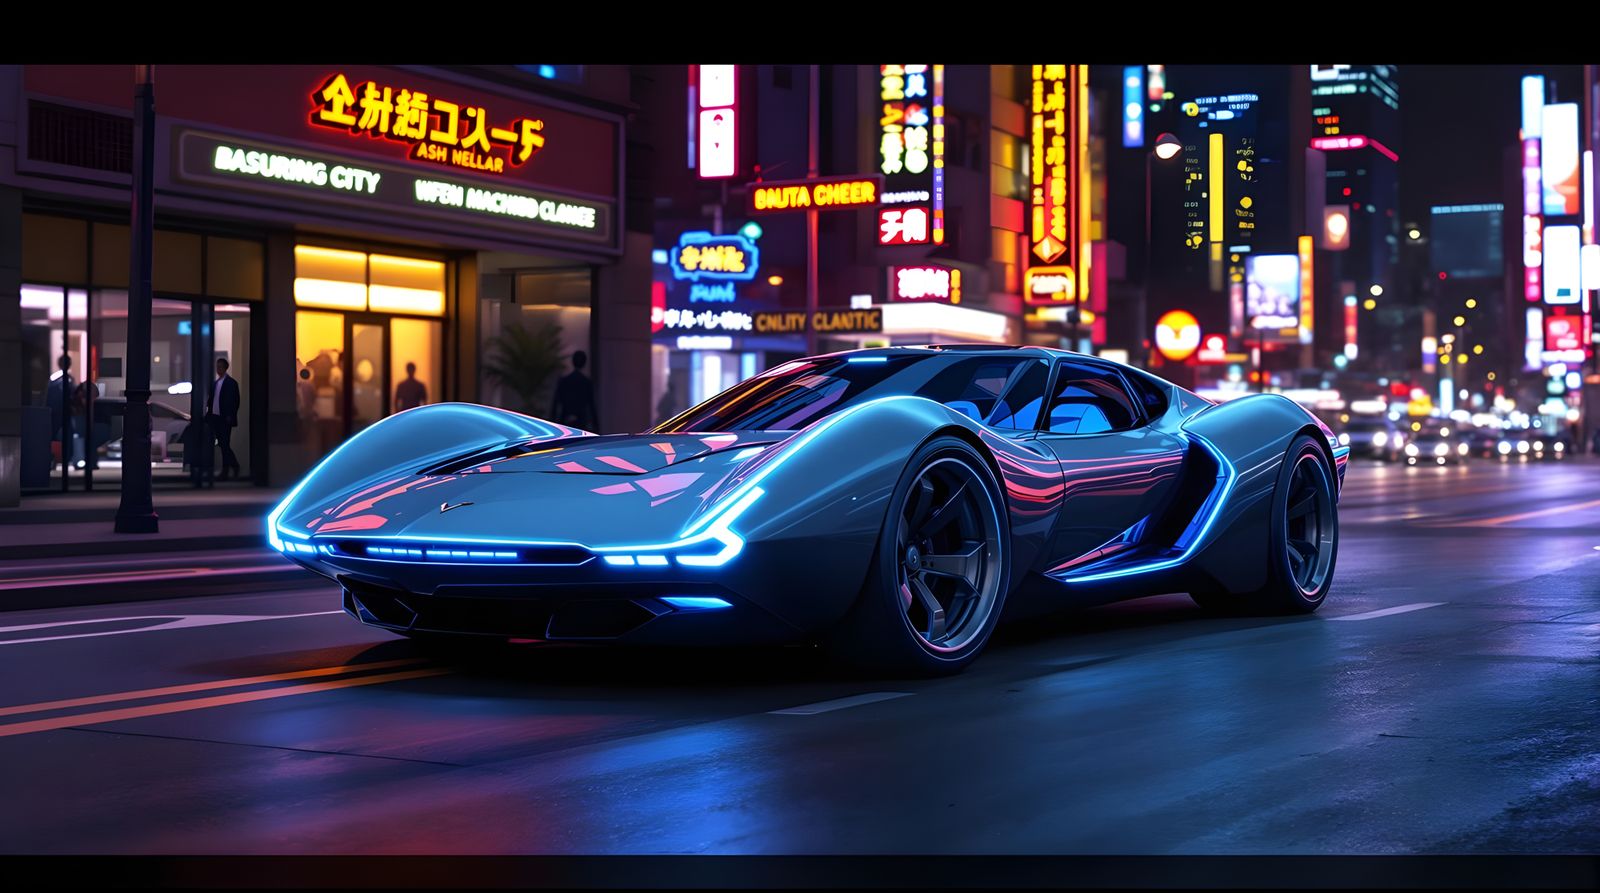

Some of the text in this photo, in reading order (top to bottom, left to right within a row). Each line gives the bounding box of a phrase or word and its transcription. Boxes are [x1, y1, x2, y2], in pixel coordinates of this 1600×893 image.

[416, 141, 504, 173] ASH NELLAR
[329, 165, 381, 194] CITY
[813, 181, 876, 206] CHEER
